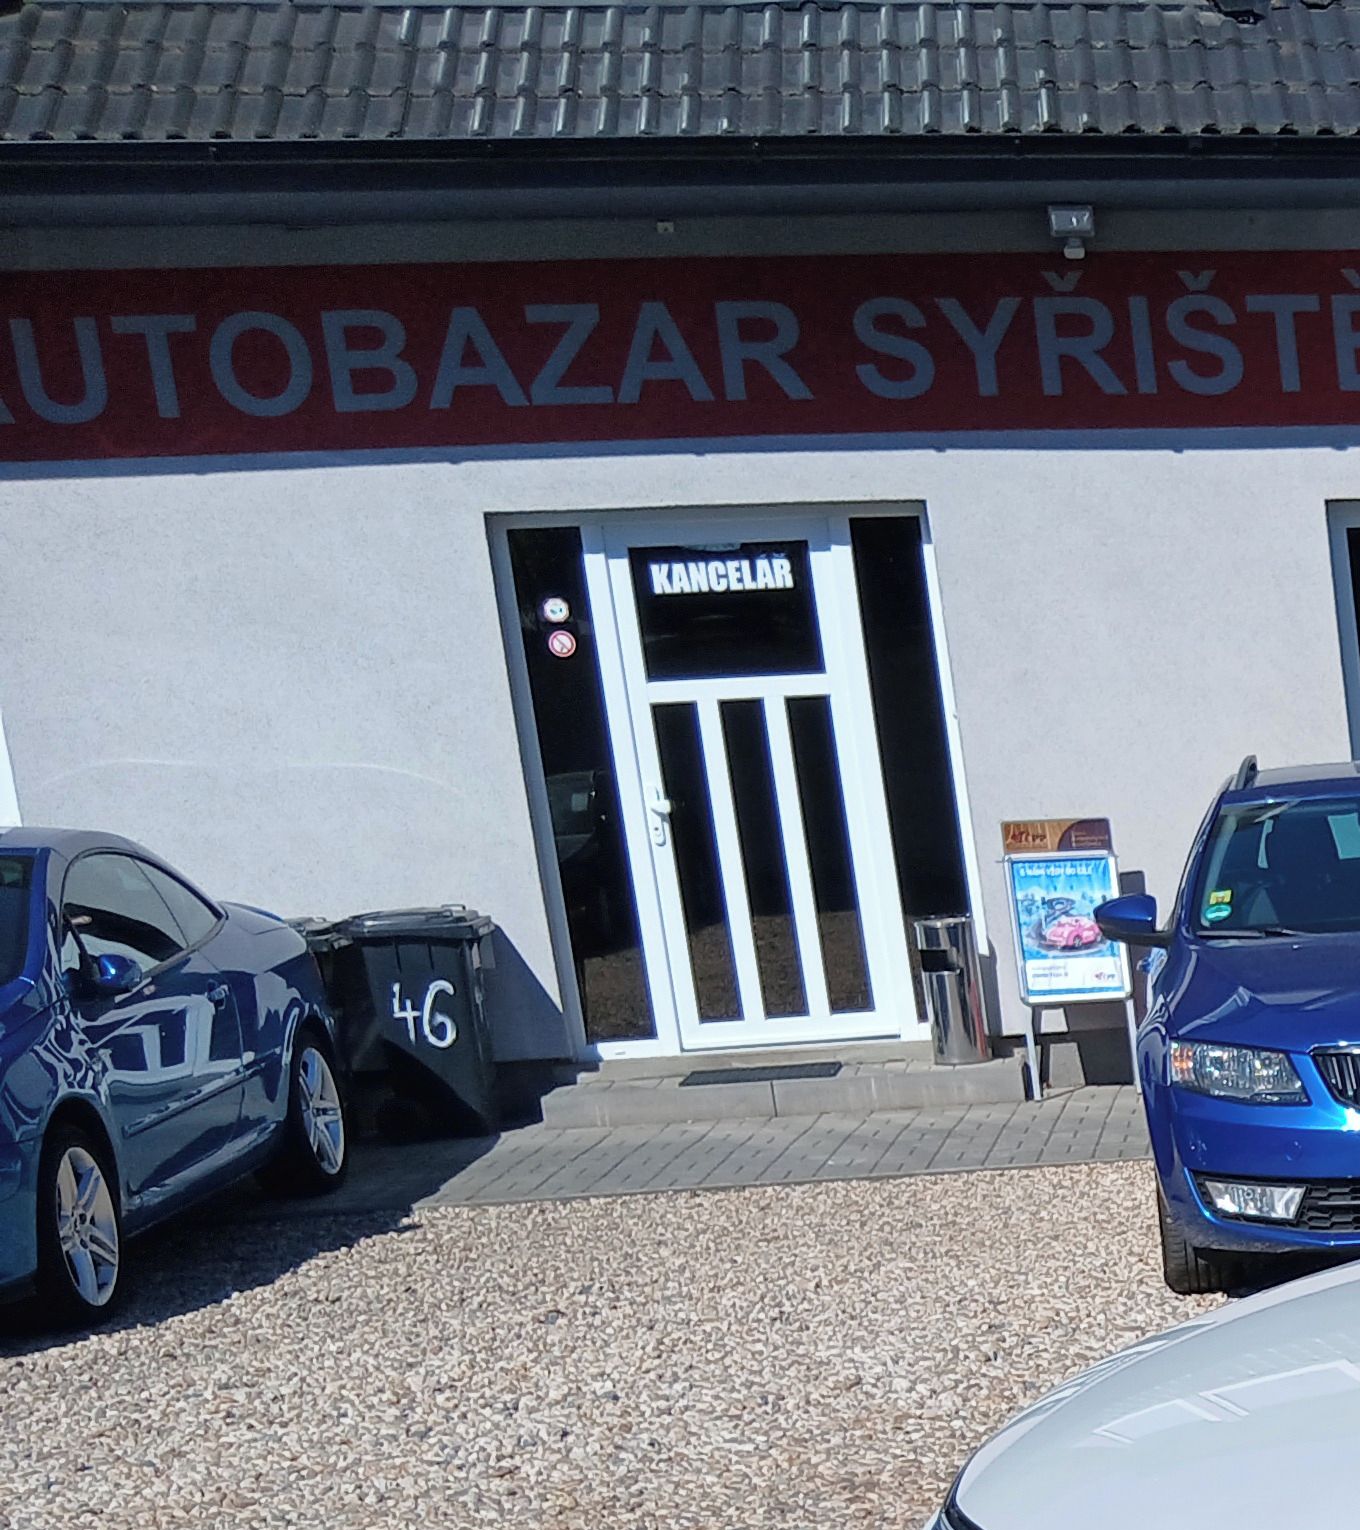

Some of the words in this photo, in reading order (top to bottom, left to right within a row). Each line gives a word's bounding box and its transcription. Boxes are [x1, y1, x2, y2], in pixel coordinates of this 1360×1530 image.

[0, 300, 815, 424] UTOBAZAR
[650, 552, 795, 596] KANCELÁŘ
[392, 979, 457, 1048] 46
